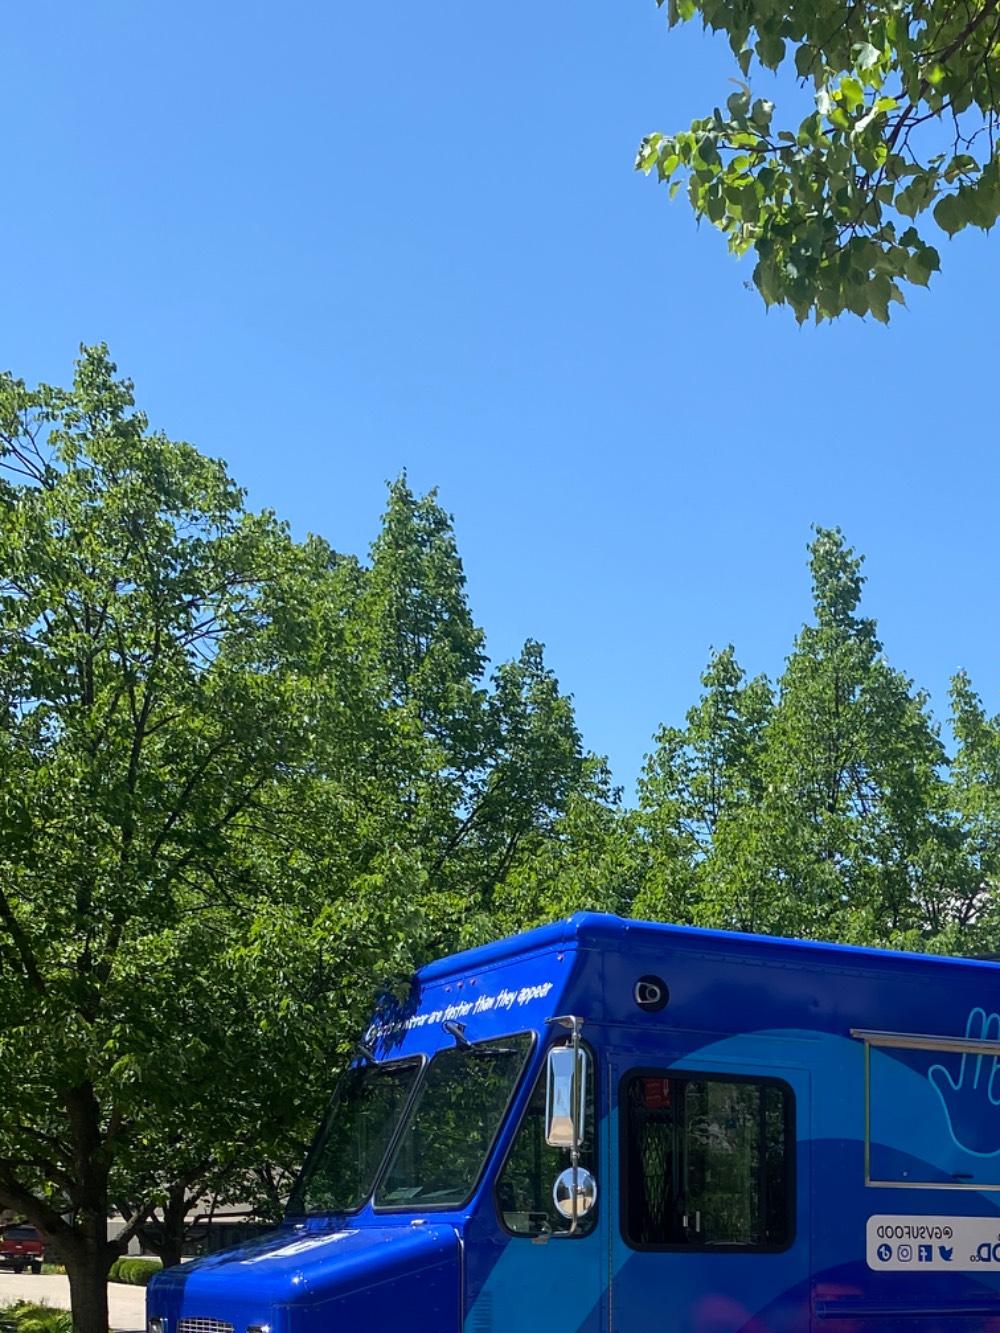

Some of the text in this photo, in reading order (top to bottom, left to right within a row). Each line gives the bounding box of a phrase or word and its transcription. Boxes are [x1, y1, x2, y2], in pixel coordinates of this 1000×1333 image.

[472, 994, 496, 1015] than
[495, 987, 518, 1011] they
[517, 982, 554, 1006] appear
